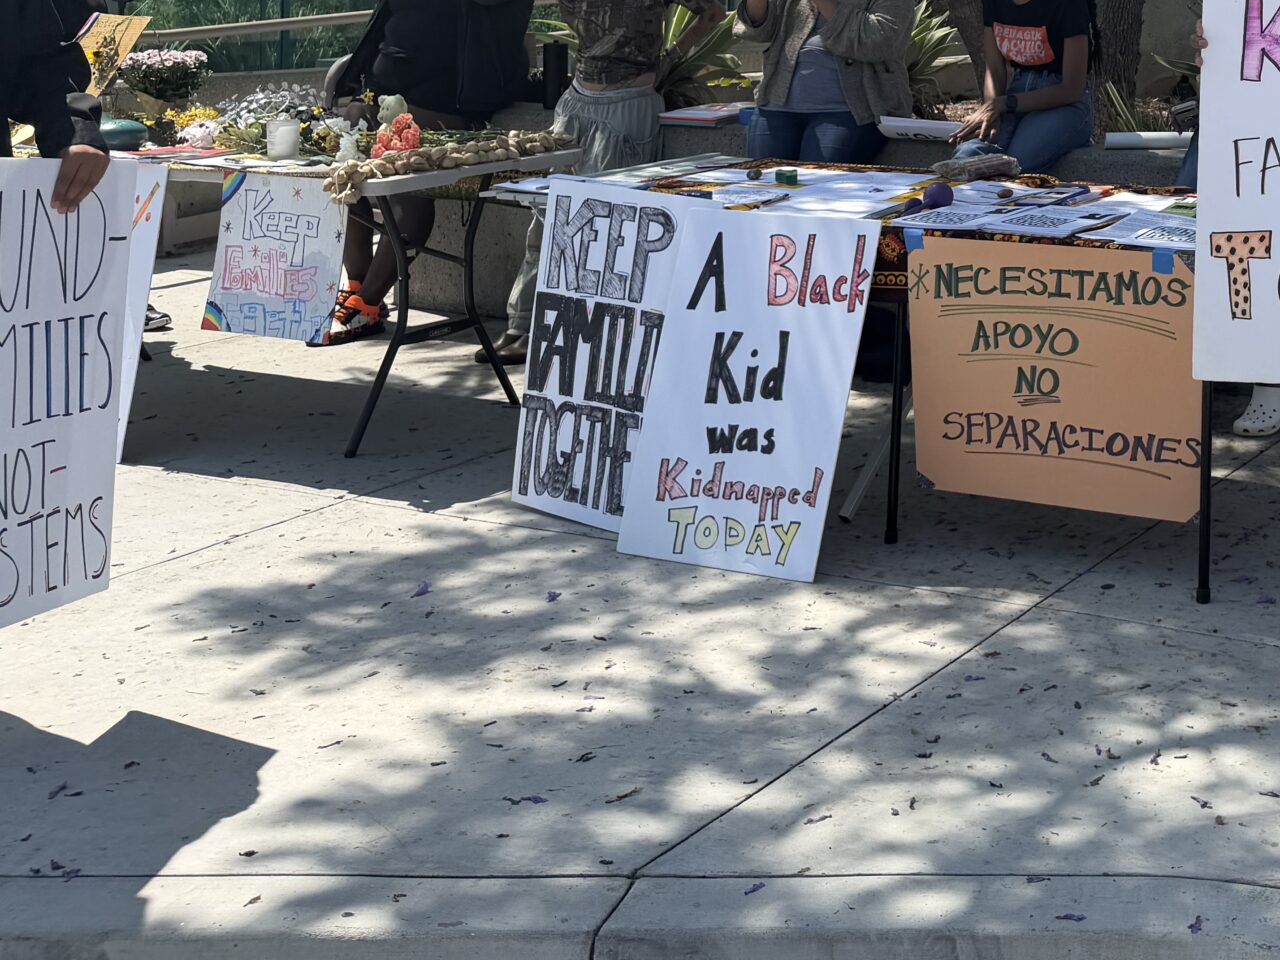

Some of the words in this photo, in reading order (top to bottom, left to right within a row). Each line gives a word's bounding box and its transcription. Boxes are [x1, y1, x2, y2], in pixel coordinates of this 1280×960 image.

[242, 189, 321, 268] Keep
[546, 194, 677, 304] KEEP
[686, 231, 727, 313] A
[767, 233, 872, 314] Black
[704, 330, 791, 405] Kid
[970, 319, 1080, 357] APOYO
[1013, 365, 1061, 396] NO
[518, 393, 645, 518] TOGETHE
[706, 424, 777, 456] was
[942, 411, 1203, 468] SEPARACIONES
[656, 456, 825, 523] Kidnapped
[667, 506, 802, 566] TODAY
